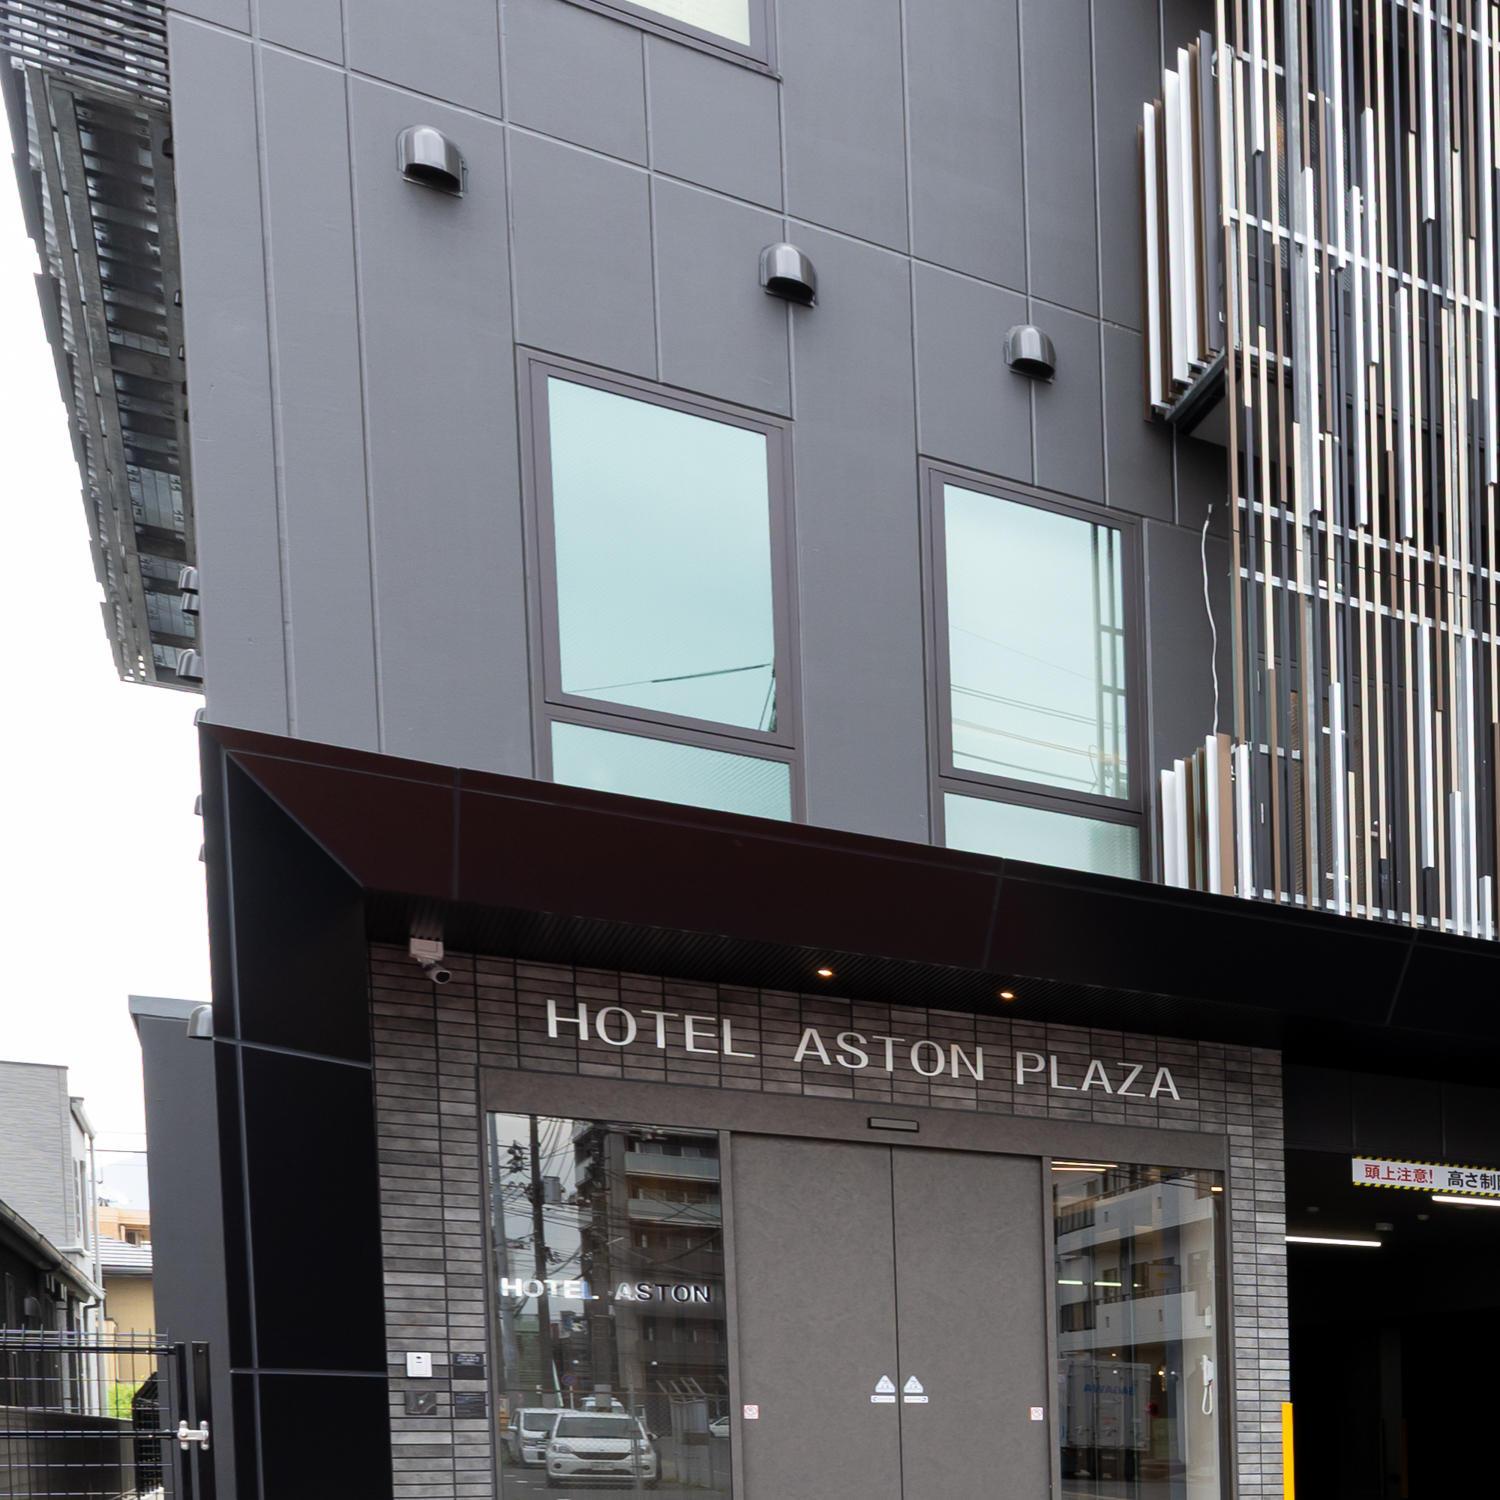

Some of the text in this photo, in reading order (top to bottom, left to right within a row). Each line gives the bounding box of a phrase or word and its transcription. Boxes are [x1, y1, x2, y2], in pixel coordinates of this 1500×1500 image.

[547, 1000, 1181, 1101] HOTEL ASTON PLAZA
[1365, 1163, 1433, 1185] 頭上注意!
[501, 1277, 711, 1303] HOTEL ASTON
